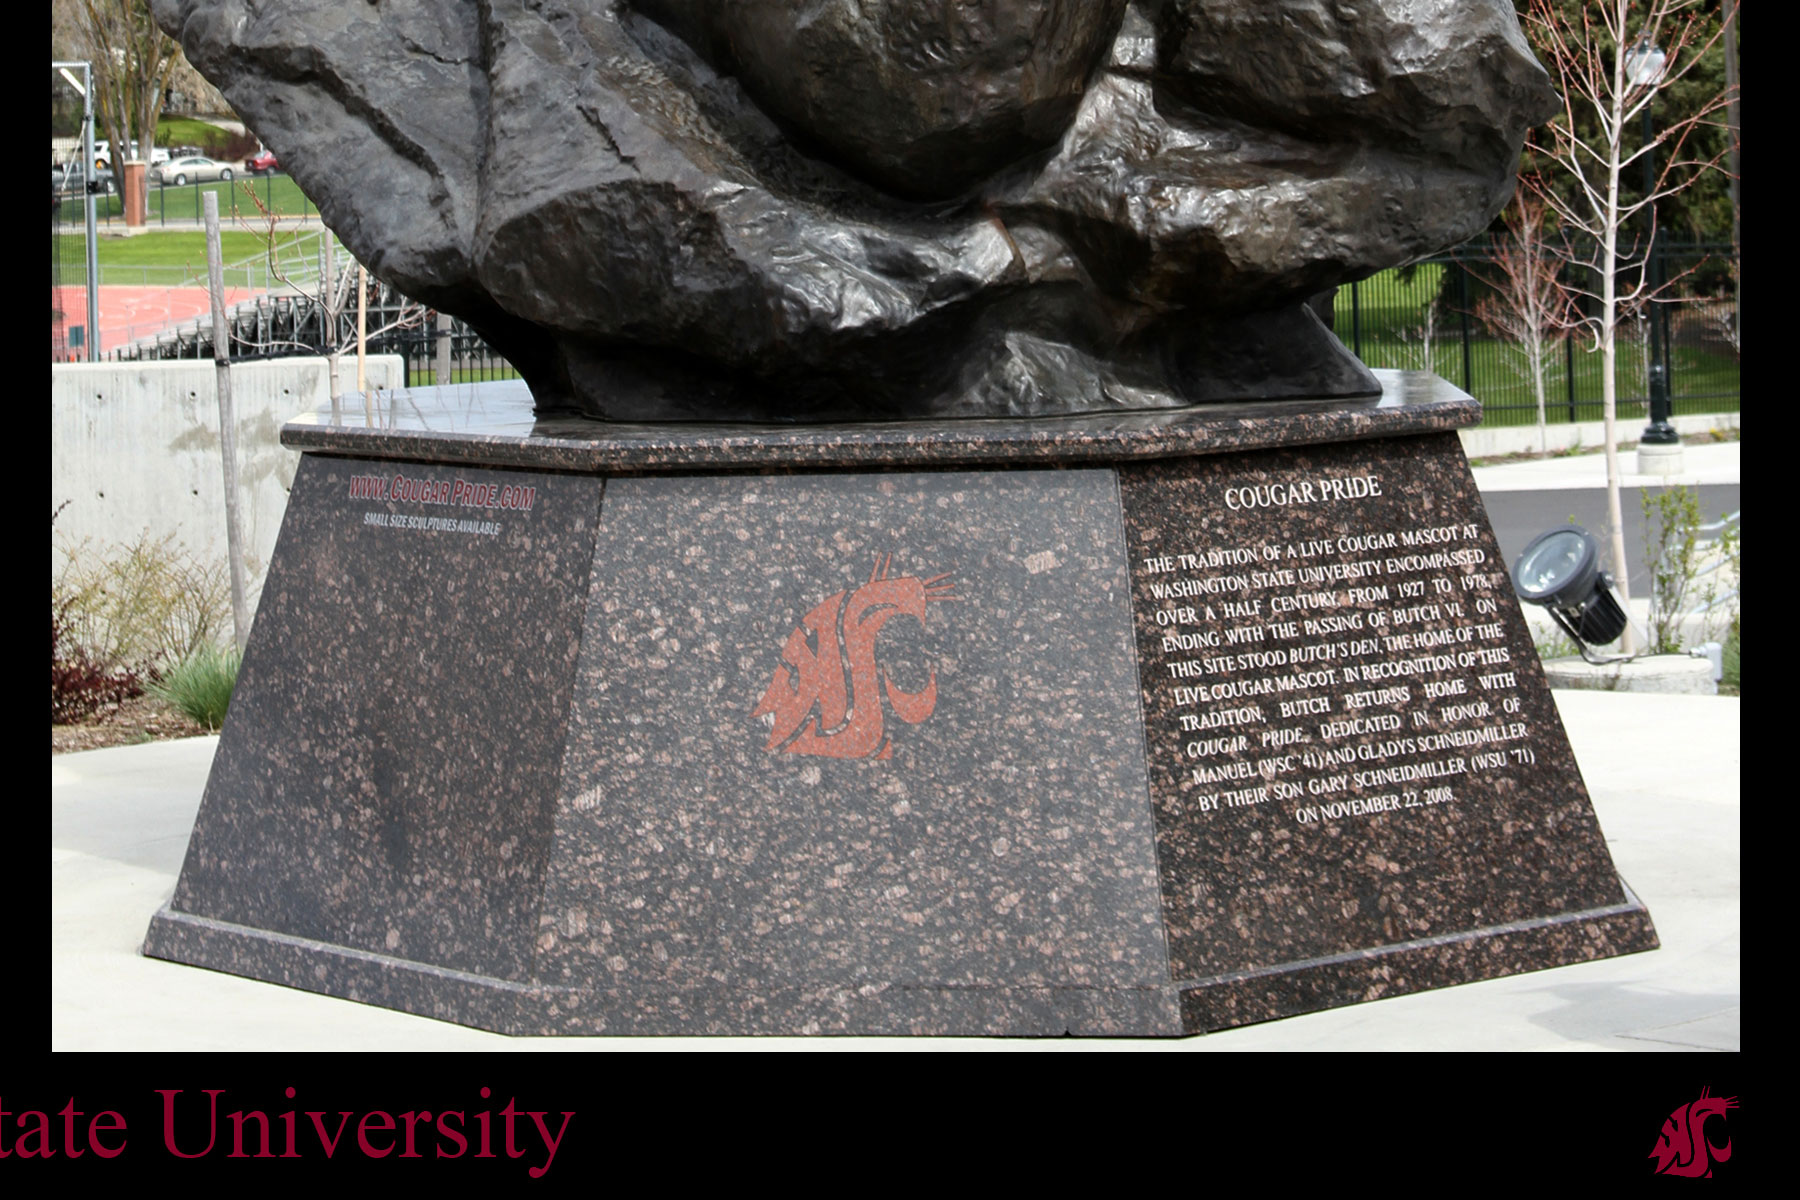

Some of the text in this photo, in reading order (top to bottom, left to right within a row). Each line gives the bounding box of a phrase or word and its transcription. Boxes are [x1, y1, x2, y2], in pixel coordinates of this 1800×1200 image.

[1225, 476, 1382, 510] COUGAR PRIDE
[364, 512, 500, 535] SMALL SIZE SCULPTURES AVAILABLE
[1144, 524, 1478, 573] THE TRADITION OF A LIVE COUGAR MASCOT AT
[1150, 549, 1485, 599] WASHINGTON STATE UNIVERSITY ENCOMPASSED
[1156, 608, 1198, 626] OVER
[1205, 606, 1217, 621] A
[1223, 600, 1261, 618] HALF
[1348, 585, 1389, 603] FROM
[1397, 582, 1424, 598] 1927
[1432, 578, 1451, 594] TO
[1162, 631, 1220, 652] ENDING
[1225, 626, 1265, 644] WITH
[1268, 622, 1299, 639] THE
[1304, 614, 1363, 635] PASSING
[1368, 612, 1387, 628] OF
[1392, 605, 1441, 624] BUTCH
[1476, 599, 1498, 614] ON
[1167, 660, 1202, 678] THIS
[1205, 656, 1237, 674] SITE
[1238, 651, 1287, 670] STOOD
[1289, 642, 1348, 663] BUTCH'S
[1383, 635, 1414, 651] THE
[1413, 630, 1455, 648] HOME
[1455, 627, 1474, 642] OF
[1475, 623, 1504, 639] THE
[1173, 648, 1510, 706] LIVE COUGAR MASCOT. IN RECOGNITION OF THIS
[1180, 672, 1517, 731] TRADITION, BUTCH RETURNS HOME WITH
[1187, 736, 1248, 758] COUGAR
[1320, 714, 1400, 739] DEDICATED
[1413, 711, 1430, 726] IN
[1441, 702, 1492, 722] HONOR
[1503, 698, 1521, 713] OF
[1192, 762, 1257, 785] MANUEL
[1259, 756, 1296, 778] (WSC
[1325, 747, 1357, 766] AND
[1358, 739, 1417, 760] GLADYS
[1417, 723, 1528, 751] SCHNEIDMILLER
[1199, 794, 1220, 812] BY
[1224, 787, 1269, 807] THEIR
[1273, 782, 1304, 800] SON
[1308, 774, 1348, 795] GARY
[1353, 759, 1468, 788] SCHNEIDMILLER
[1471, 752, 1507, 772] (WSU
[1296, 787, 1457, 824] ON NOVEMBER 22, 2008.
